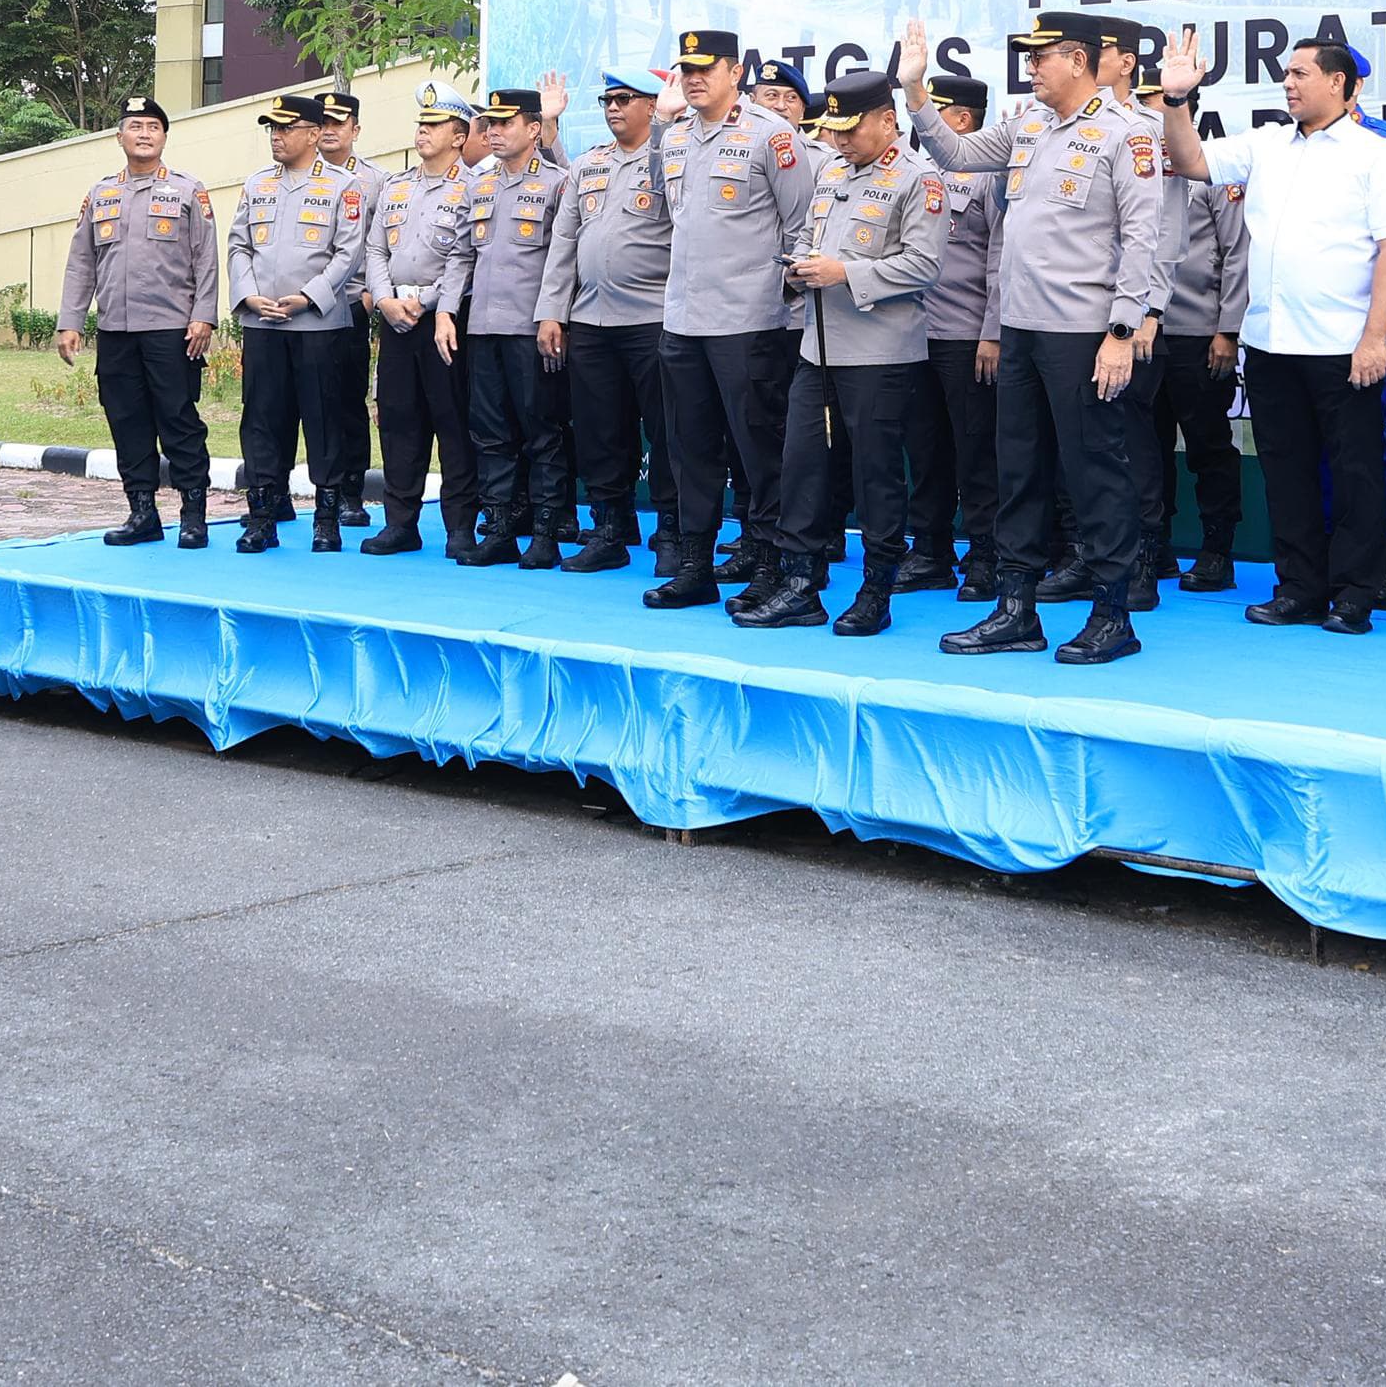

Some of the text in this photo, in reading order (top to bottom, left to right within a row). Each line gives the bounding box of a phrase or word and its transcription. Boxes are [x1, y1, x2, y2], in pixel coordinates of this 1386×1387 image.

[737, 36, 972, 93] ATGS
[1129, 136, 1152, 145] POLDA
[1067, 140, 1101, 154] POLRI
[718, 148, 750, 159] POLRI
[151, 195, 181, 203] POLRI
[517, 195, 546, 204] POLRI
[862, 189, 893, 202] POLRI
[303, 198, 331, 207] POLRI
[385, 203, 409, 212] JEKI
